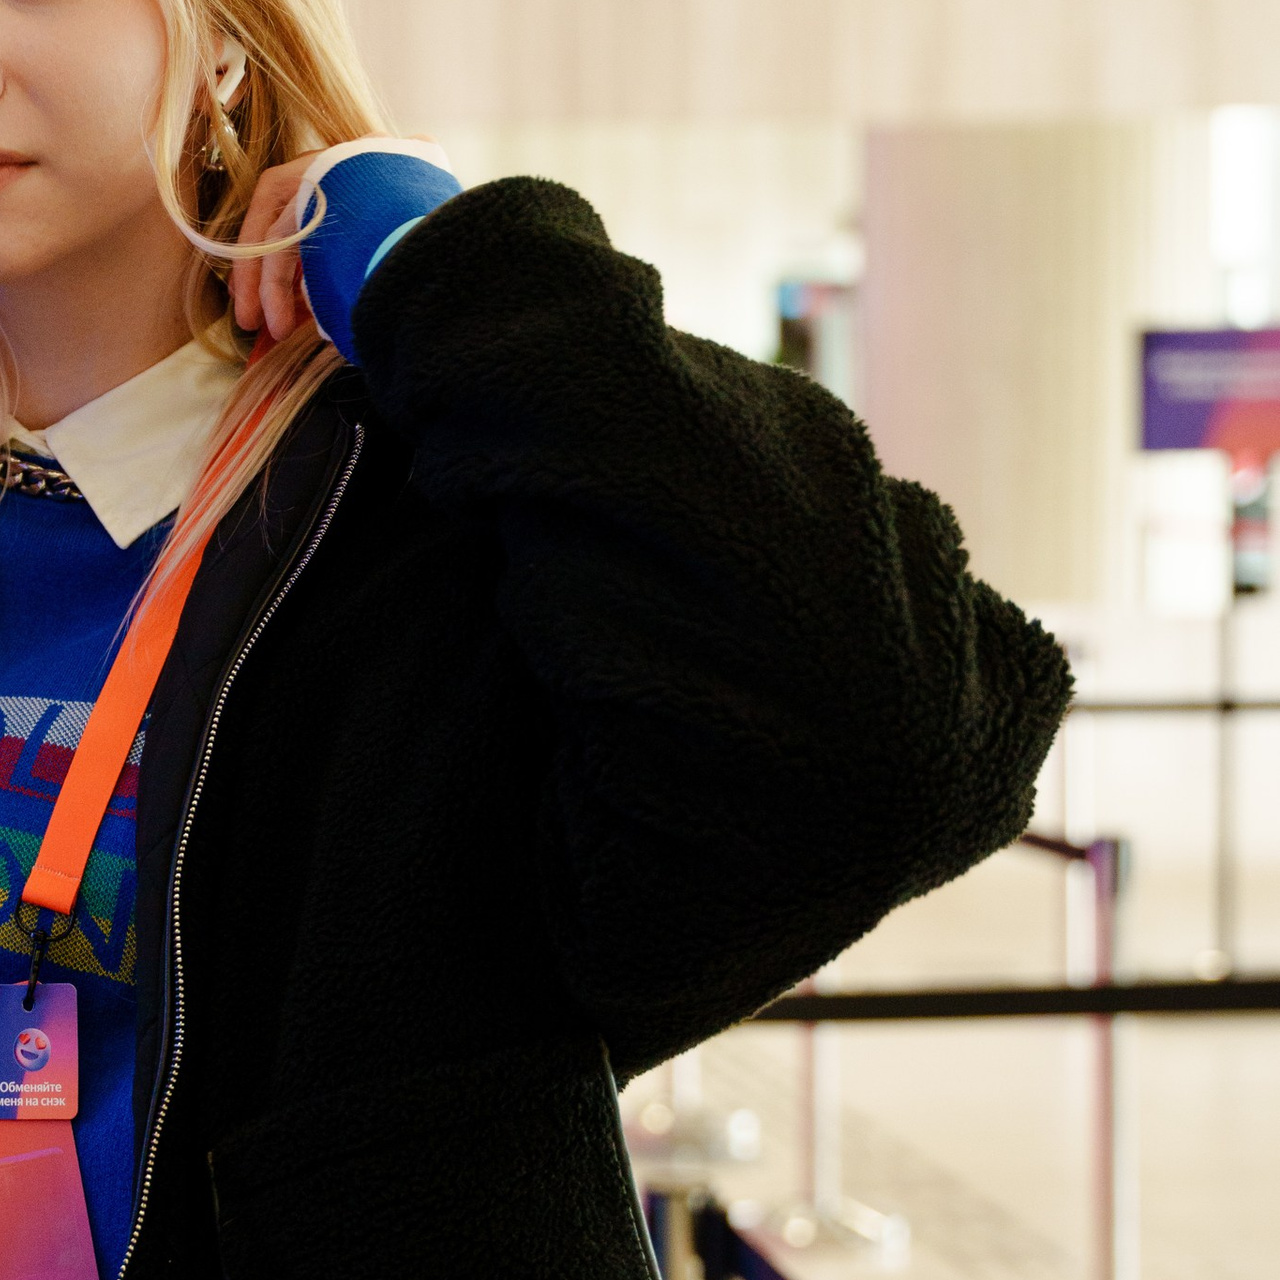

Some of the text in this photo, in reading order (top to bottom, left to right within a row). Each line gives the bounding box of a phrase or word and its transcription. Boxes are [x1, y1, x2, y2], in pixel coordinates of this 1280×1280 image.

[0, 1081, 62, 1093] Обменяйте
[25, 1097, 38, 1107] на
[40, 1097, 66, 1107] снэк
